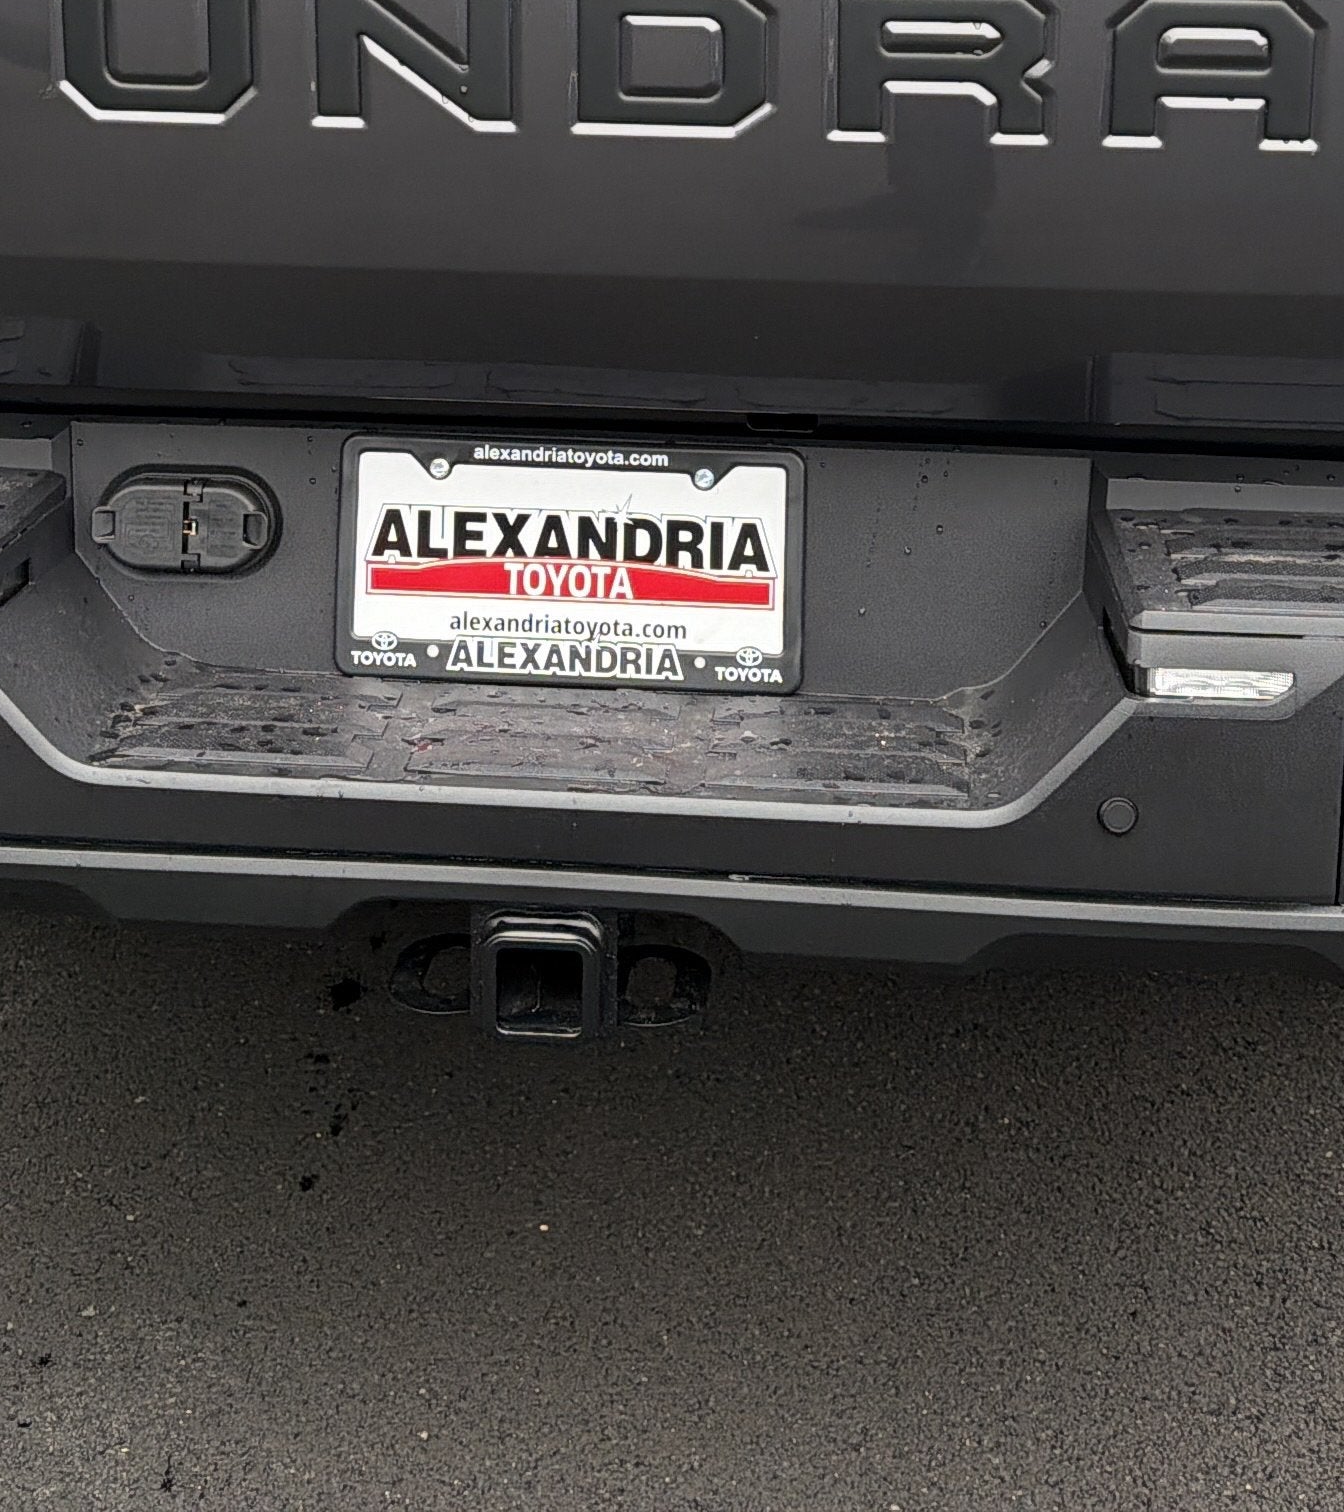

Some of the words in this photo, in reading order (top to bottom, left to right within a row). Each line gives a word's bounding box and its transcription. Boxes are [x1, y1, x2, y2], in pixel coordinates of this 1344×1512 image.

[473, 444, 669, 467] alexandriatoyota.com
[372, 508, 771, 573] ALEXANDRIA
[504, 562, 634, 600] TOYOTA
[449, 613, 687, 640] alexandriatoyota.com
[351, 650, 417, 669] TOYOTA
[447, 639, 684, 680] ALEXANDRIA
[715, 666, 783, 685] TOYOTA
